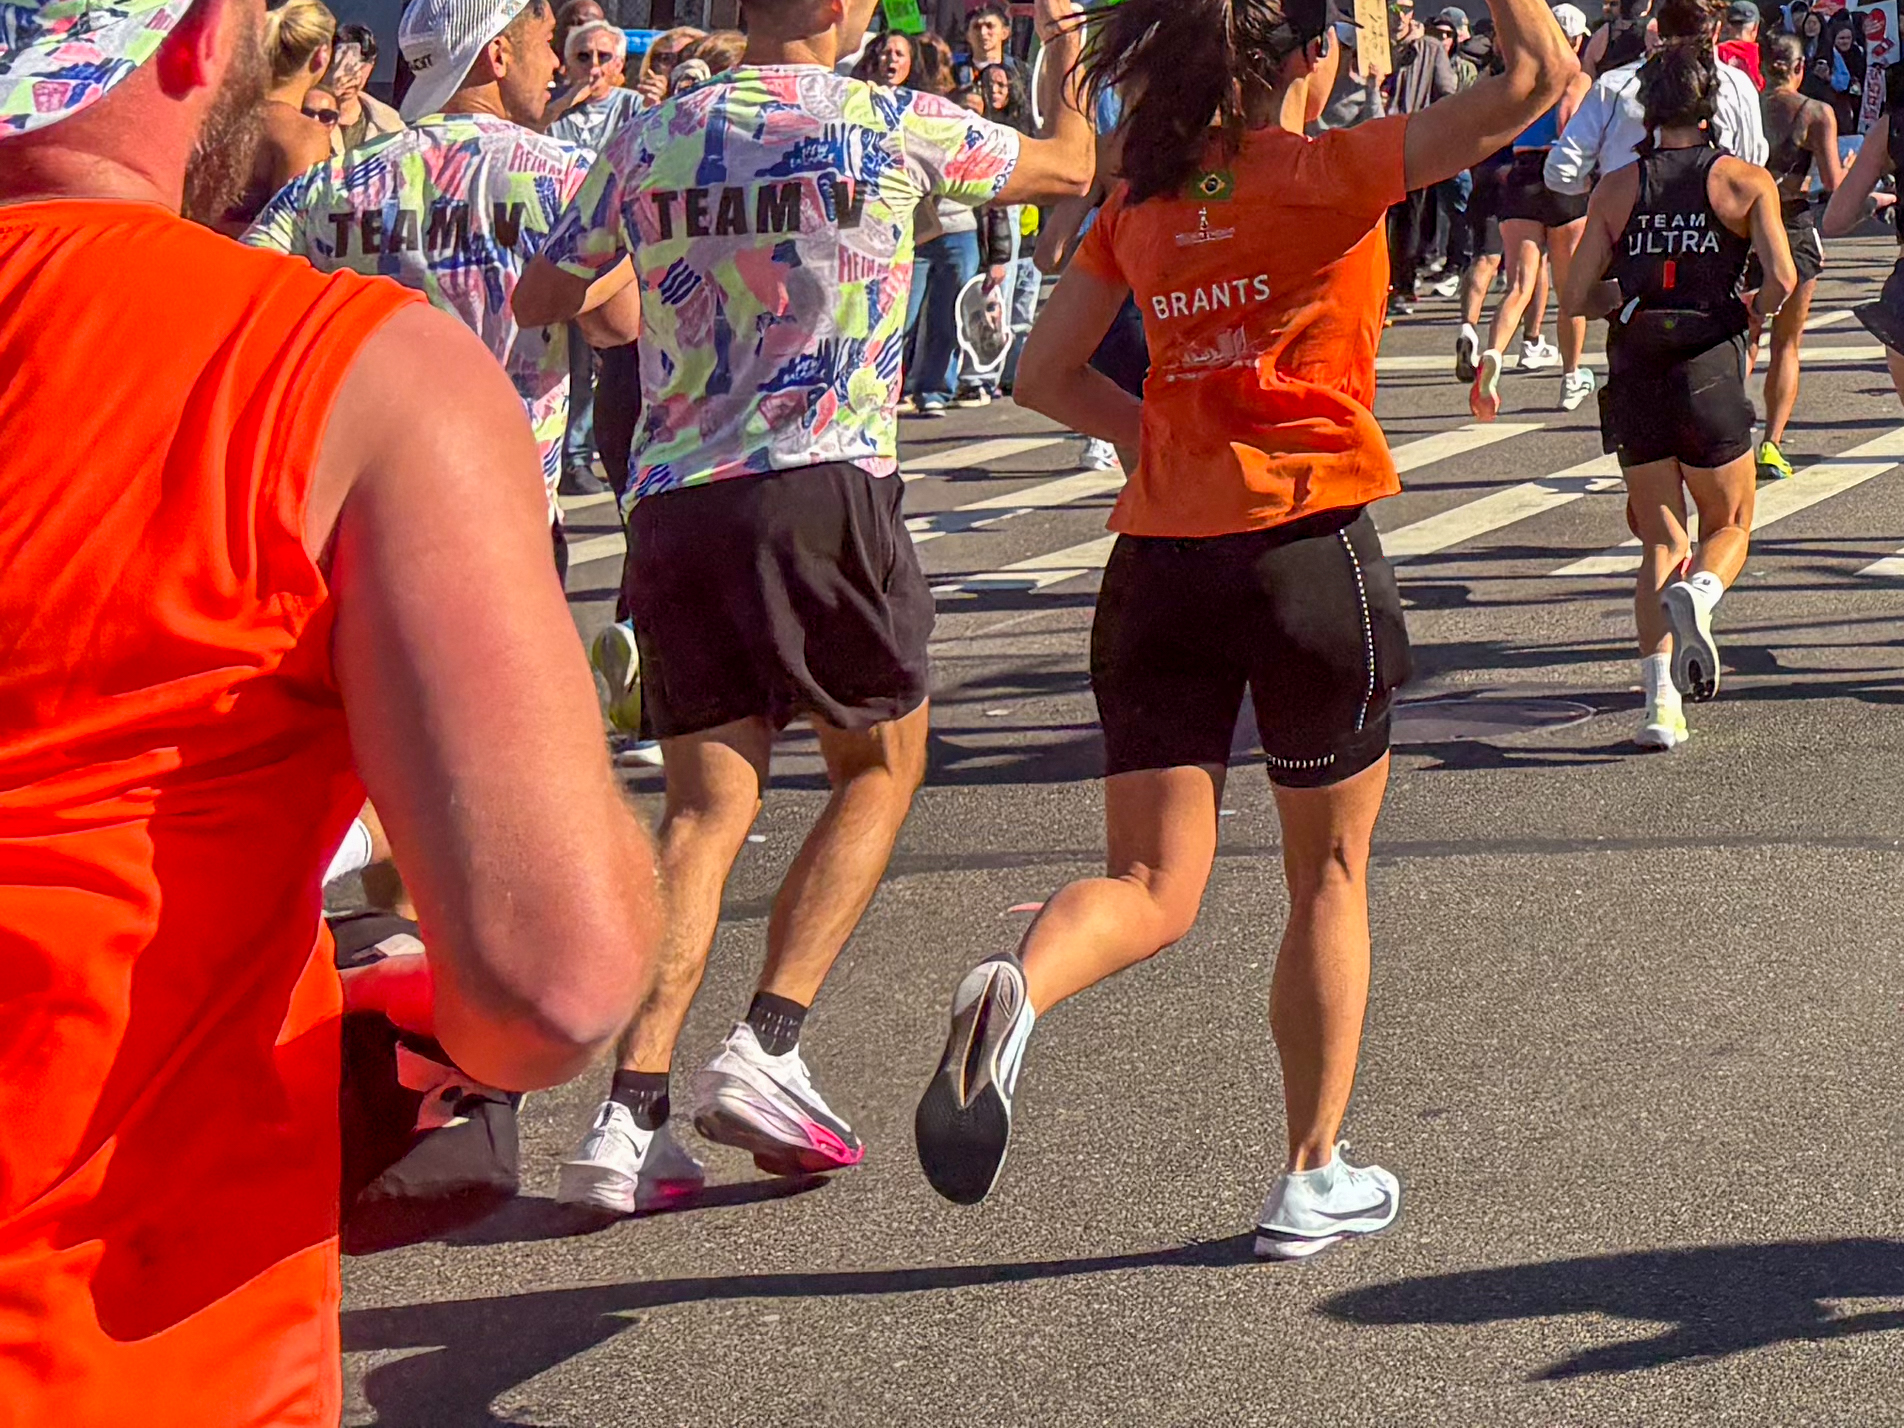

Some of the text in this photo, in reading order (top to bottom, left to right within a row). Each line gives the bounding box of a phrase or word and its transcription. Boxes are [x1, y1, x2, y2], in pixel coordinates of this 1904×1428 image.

[328, 201, 527, 258] TEAM V
[651, 179, 869, 241] TEAM V
[1638, 213, 1706, 229] TEAM
[1628, 230, 1719, 256] ULTRA
[1152, 274, 1270, 320] BRANTS
